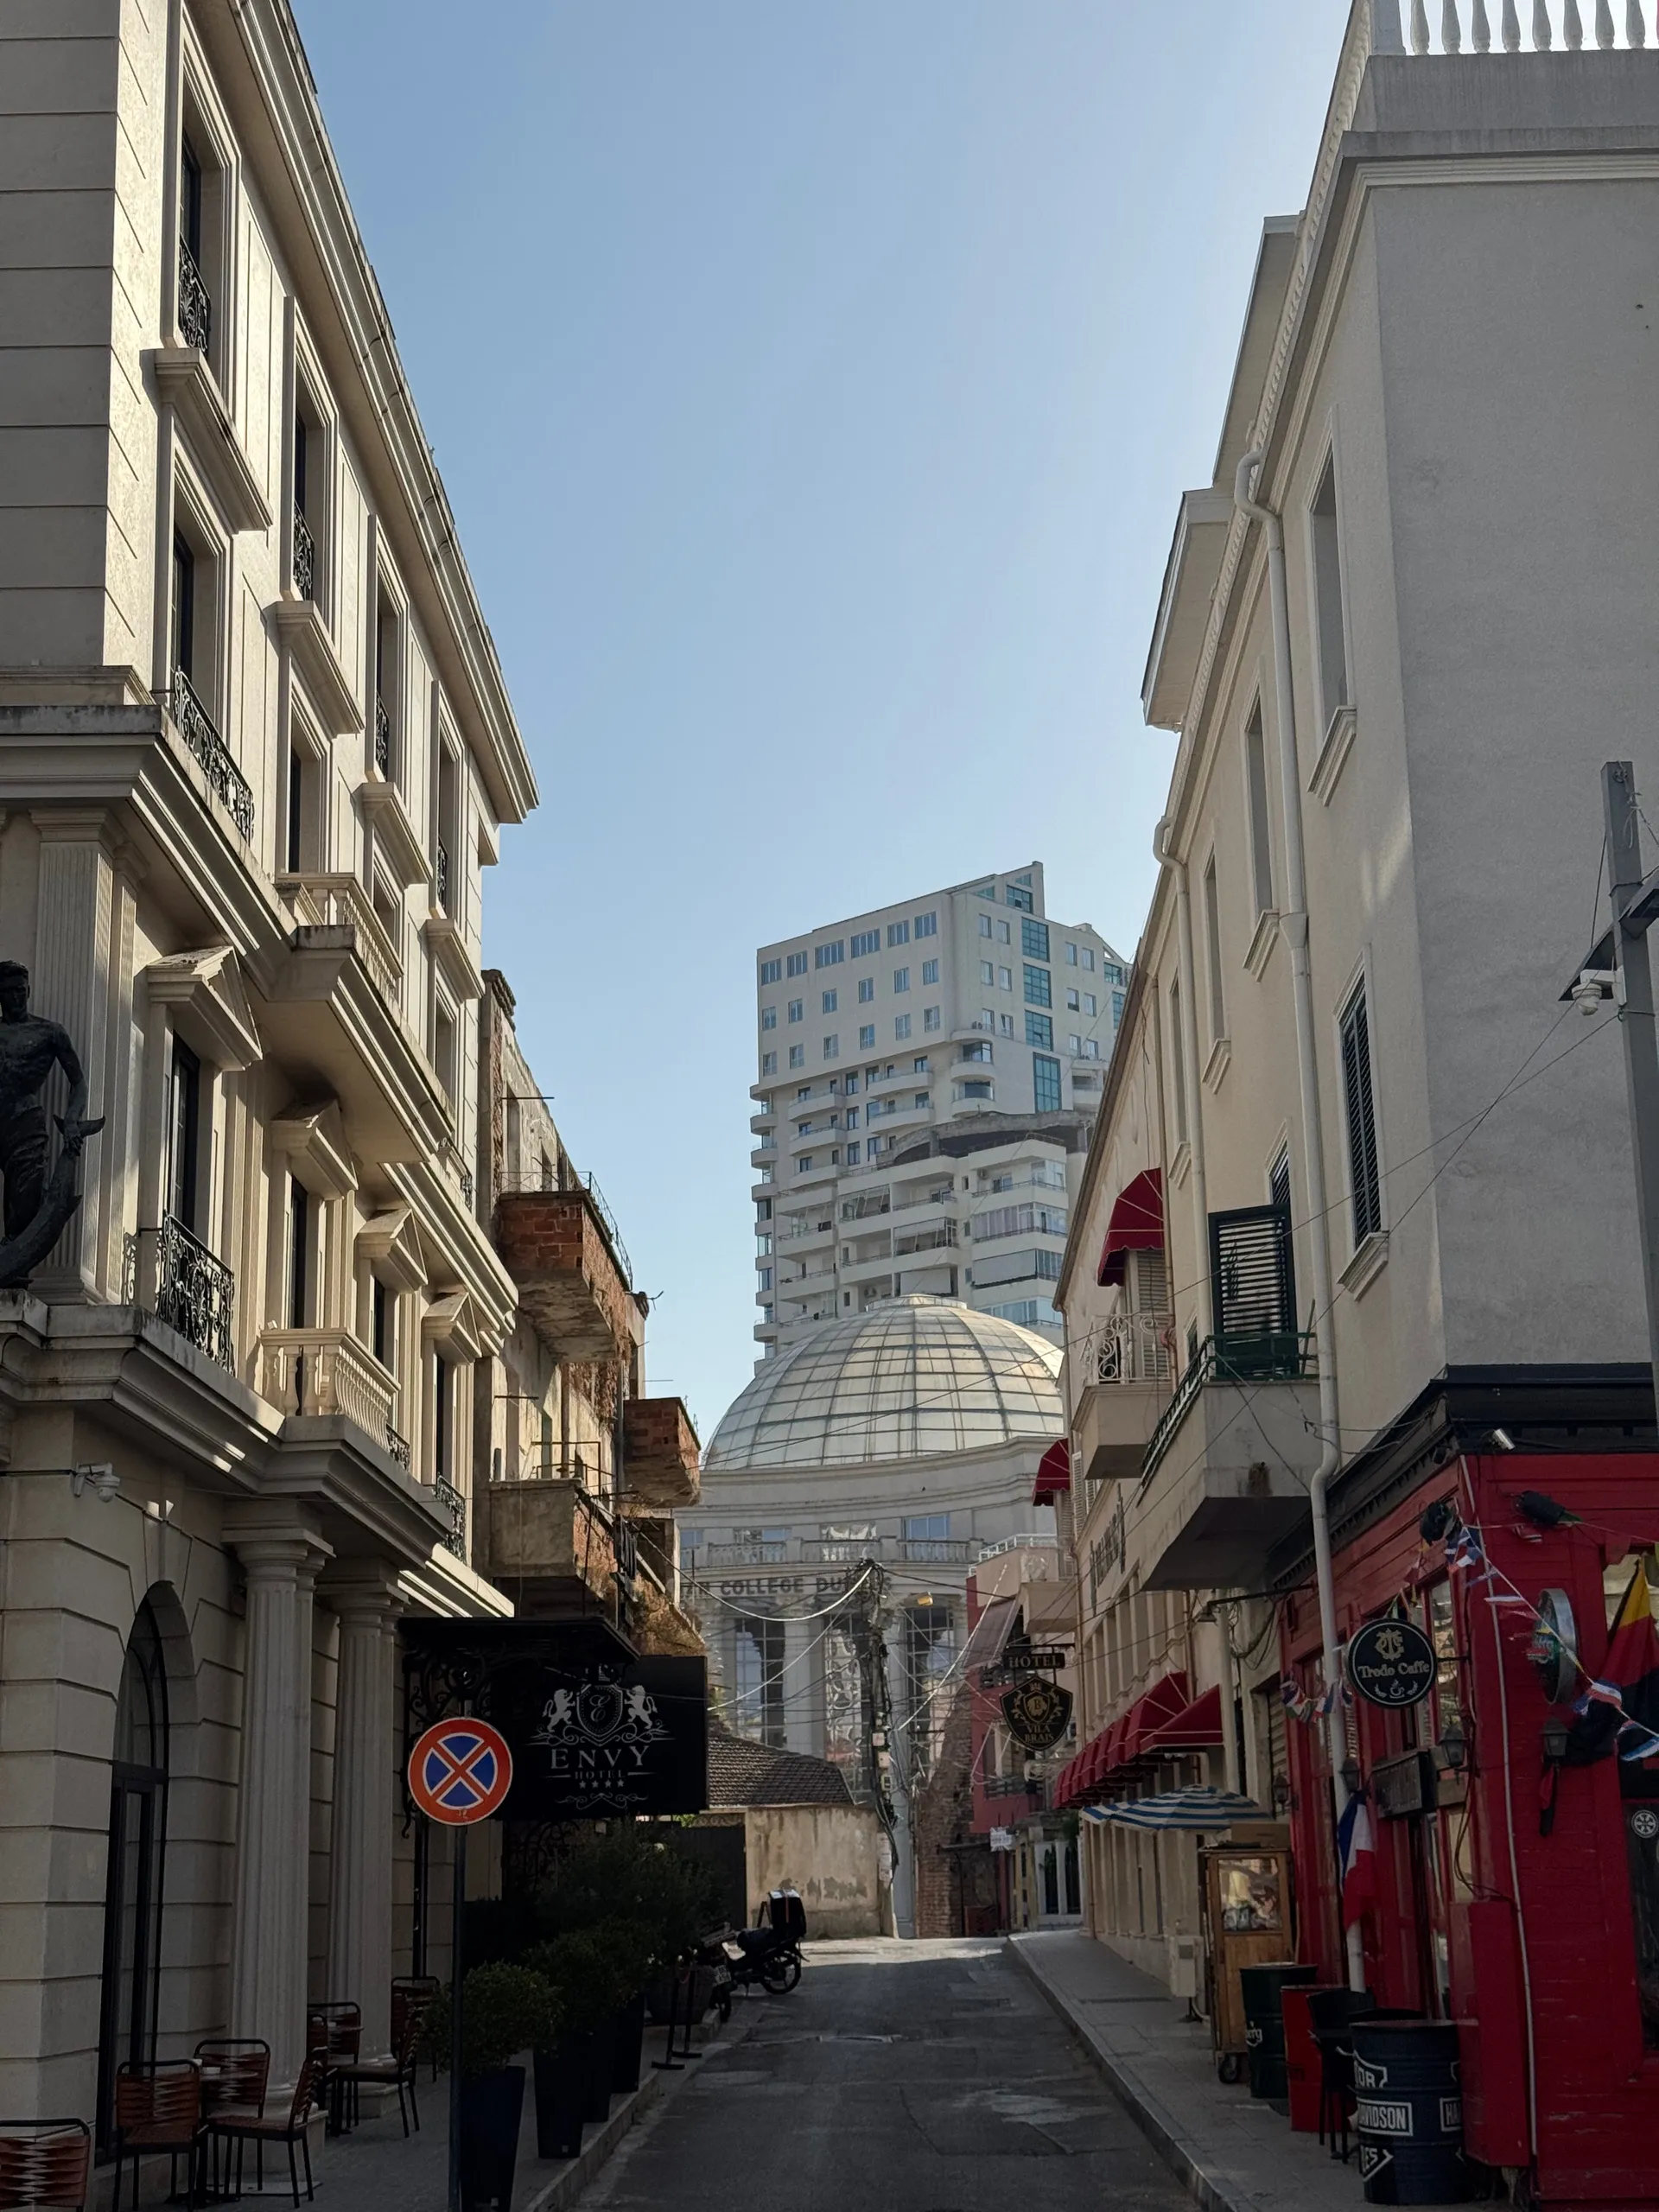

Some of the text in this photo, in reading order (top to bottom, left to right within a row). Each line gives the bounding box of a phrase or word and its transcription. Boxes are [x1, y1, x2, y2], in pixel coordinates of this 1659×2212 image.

[721, 1578, 804, 1595] COLLEGE
[1008, 1656, 1060, 1668] HOTEL
[1357, 1660, 1430, 1679] Trodo Caffe
[550, 1745, 650, 1770] ENVY
[574, 1769, 626, 1780] HOTEL
